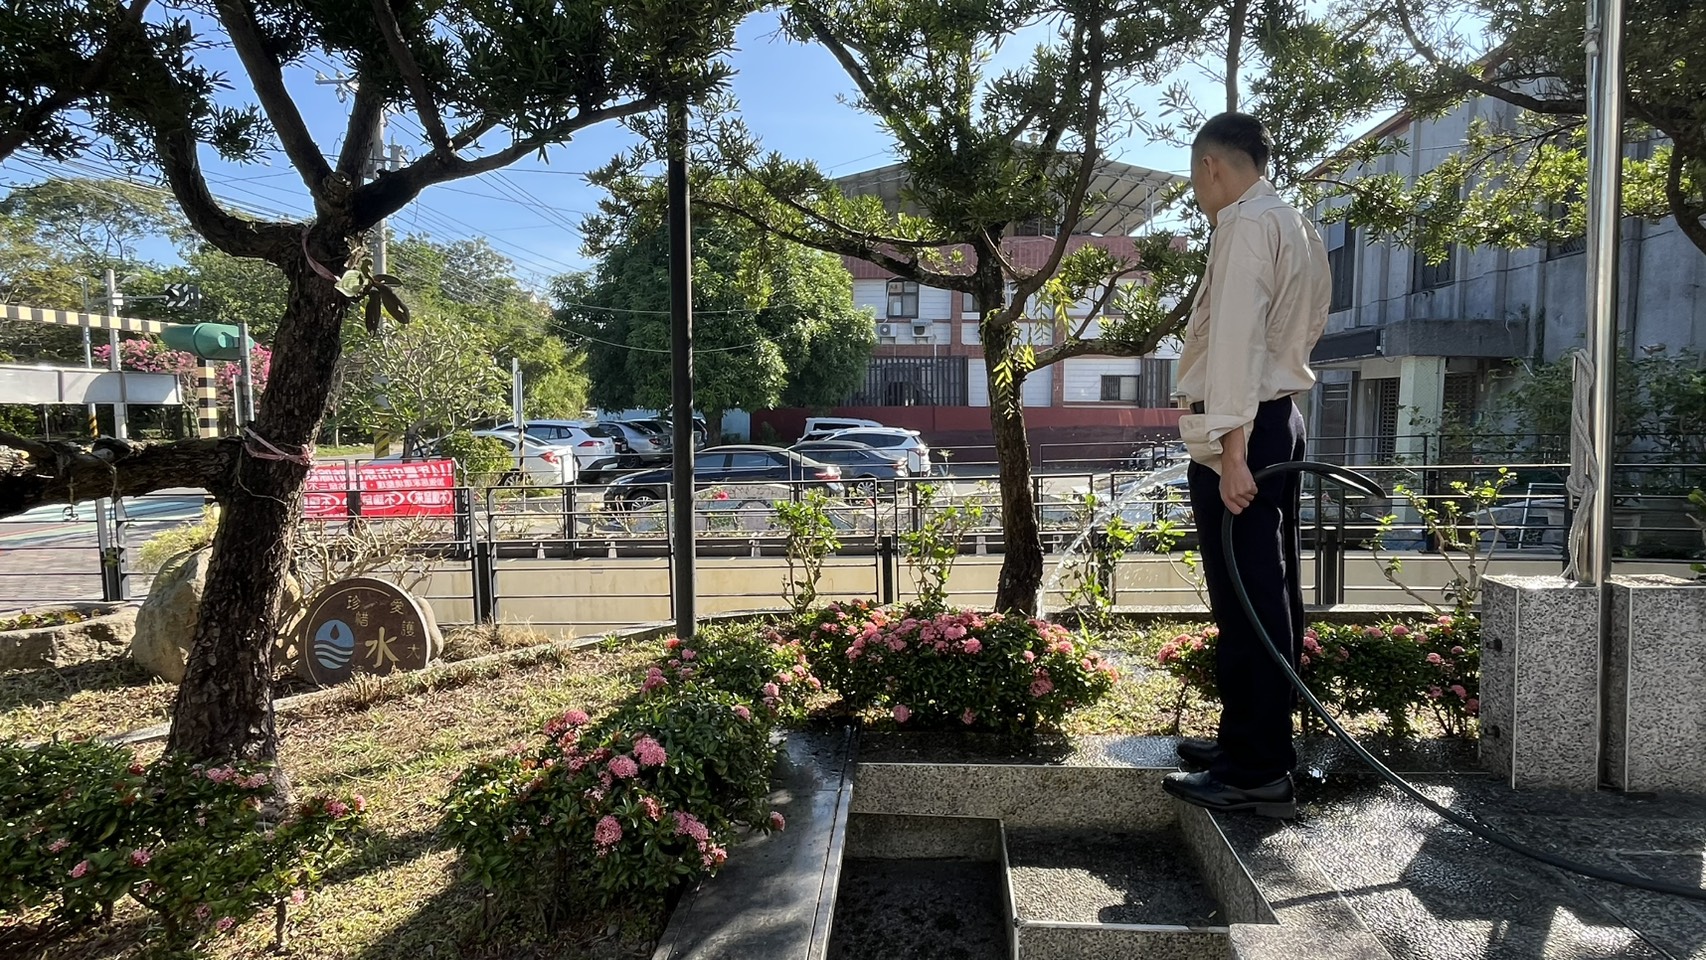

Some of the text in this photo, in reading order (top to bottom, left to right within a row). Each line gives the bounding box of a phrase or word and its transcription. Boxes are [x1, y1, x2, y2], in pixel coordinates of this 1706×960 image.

[346, 594, 369, 627] 珍惜
[365, 626, 400, 668] 水
[389, 598, 420, 671] 愛護大
